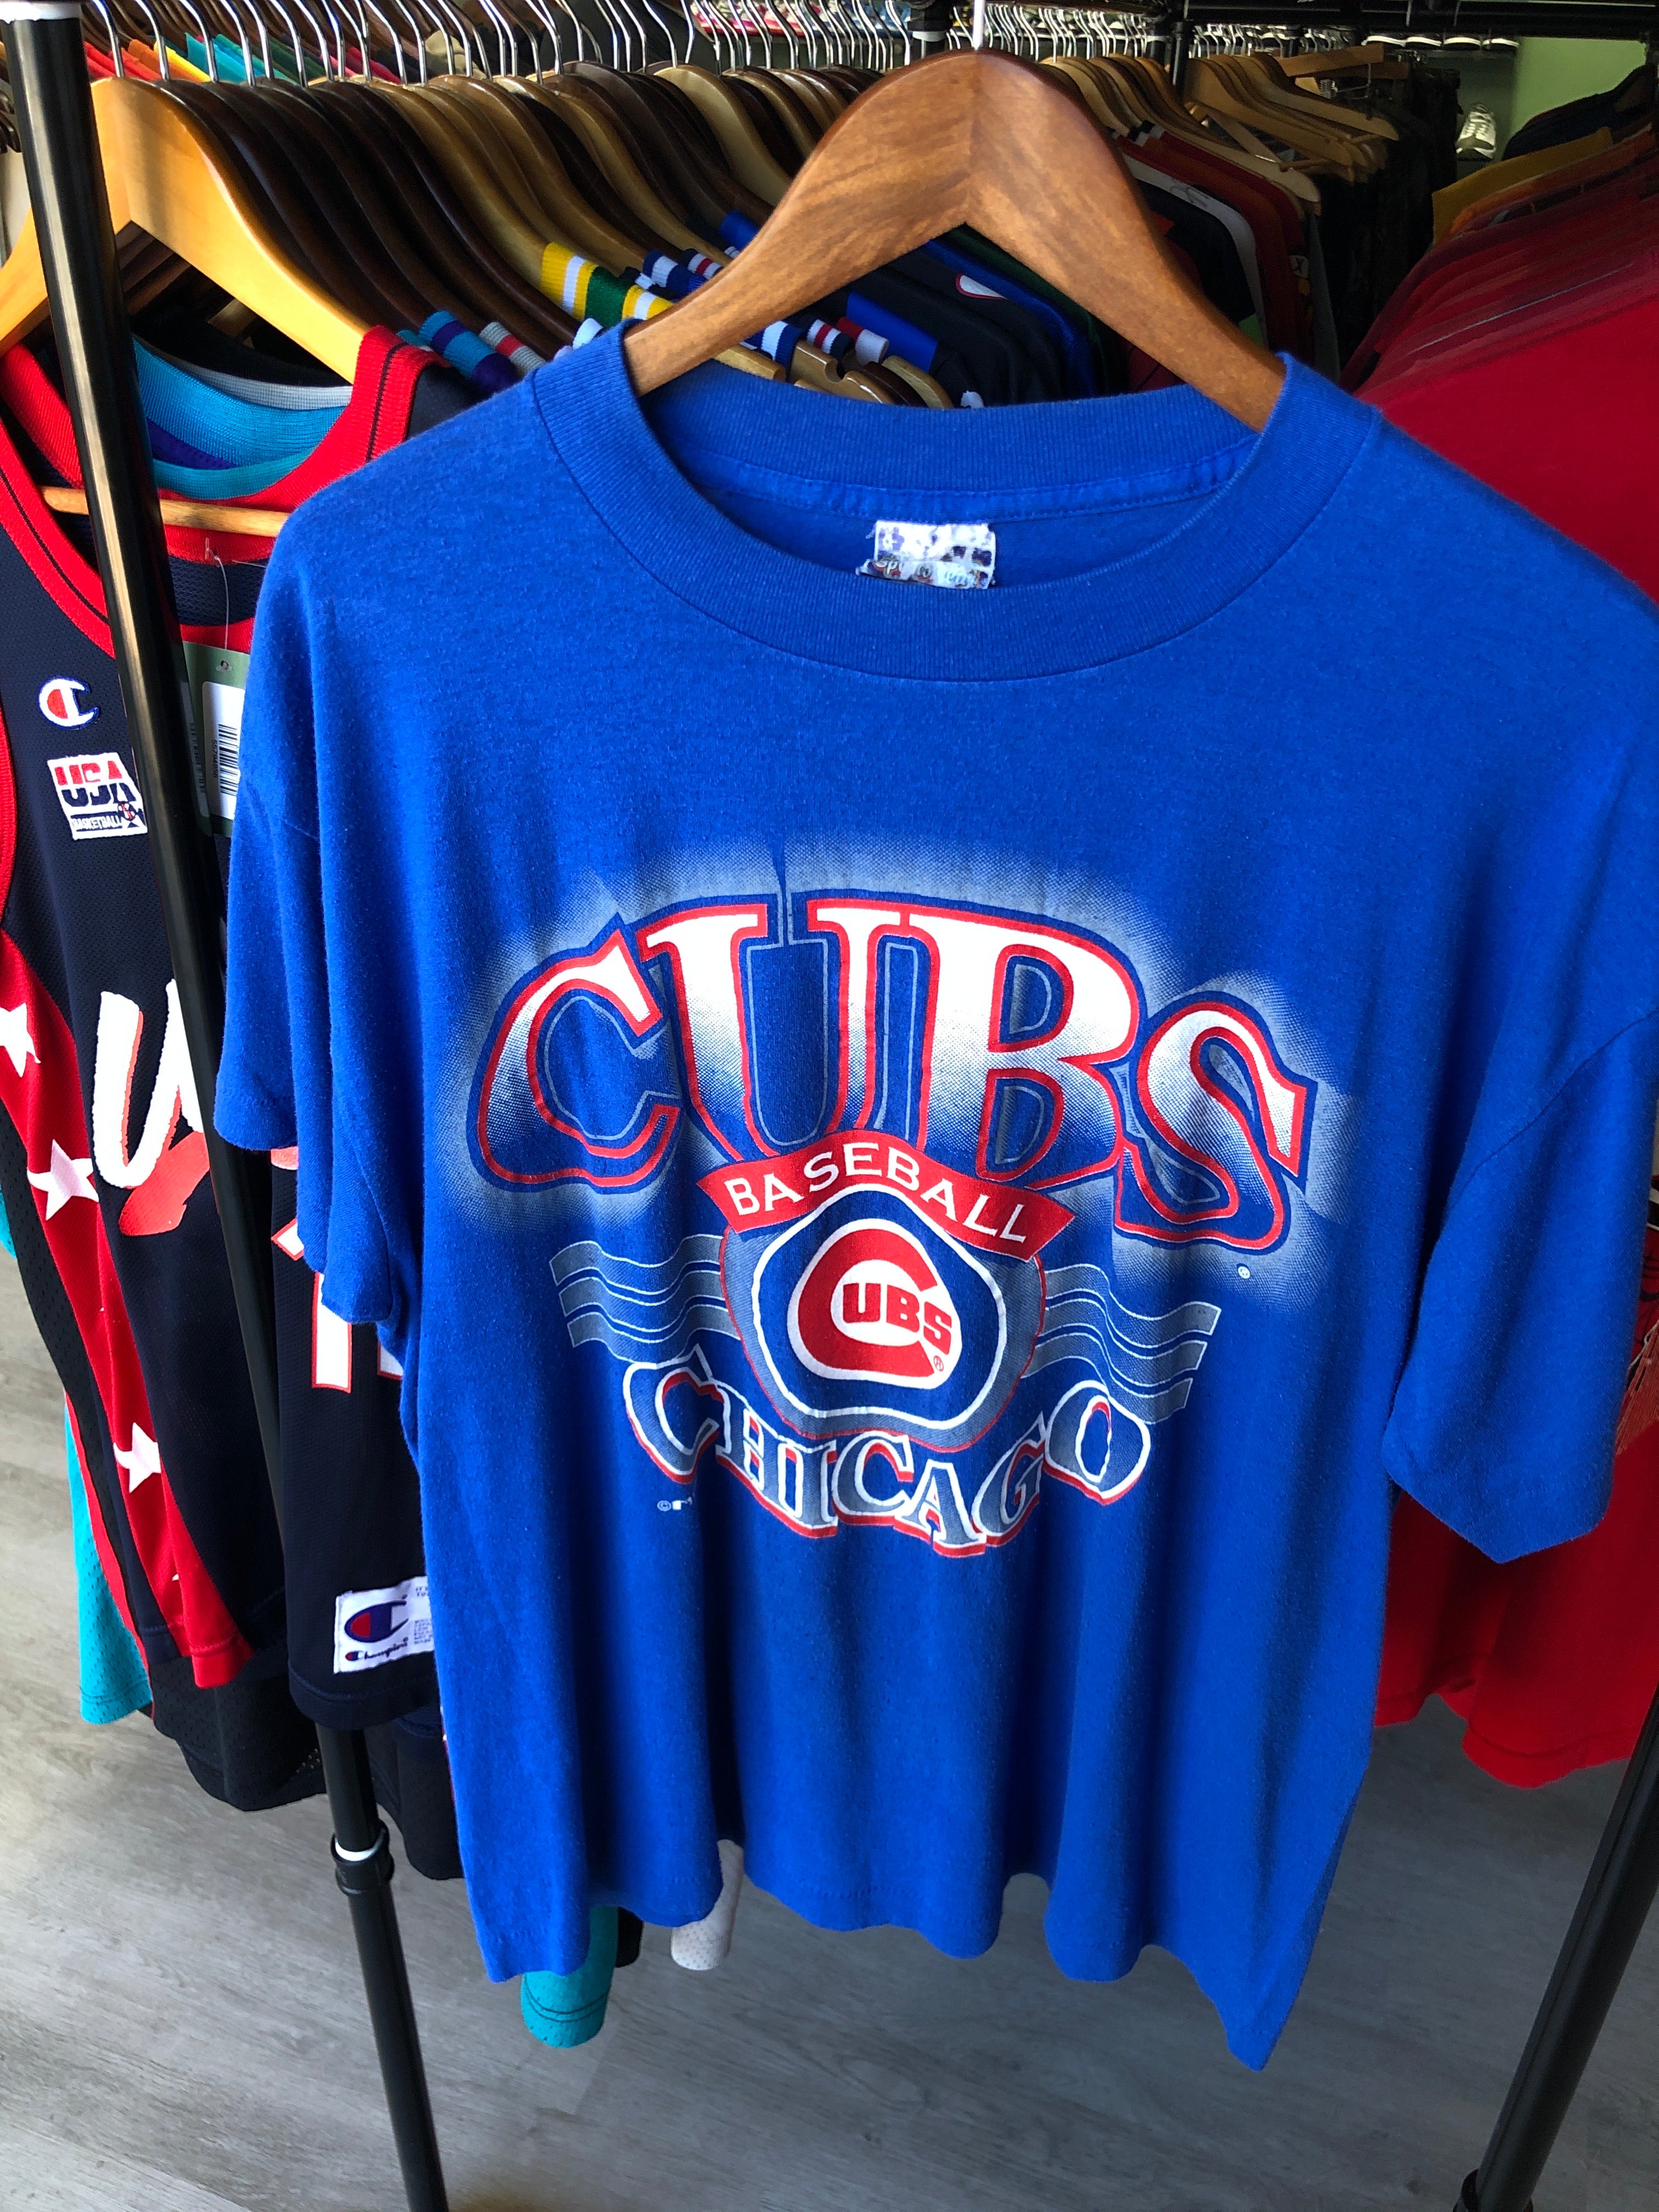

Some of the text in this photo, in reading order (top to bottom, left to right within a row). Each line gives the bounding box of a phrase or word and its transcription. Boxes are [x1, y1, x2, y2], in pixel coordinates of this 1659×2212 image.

[55, 760, 136, 807] USA
[71, 814, 122, 830] BASKETBALL
[477, 896, 1309, 1252] CUBS
[729, 1141, 1027, 1244] BASEBALL
[798, 1228, 952, 1378] CUBS
[623, 1355, 1151, 1558] CHICAGO
